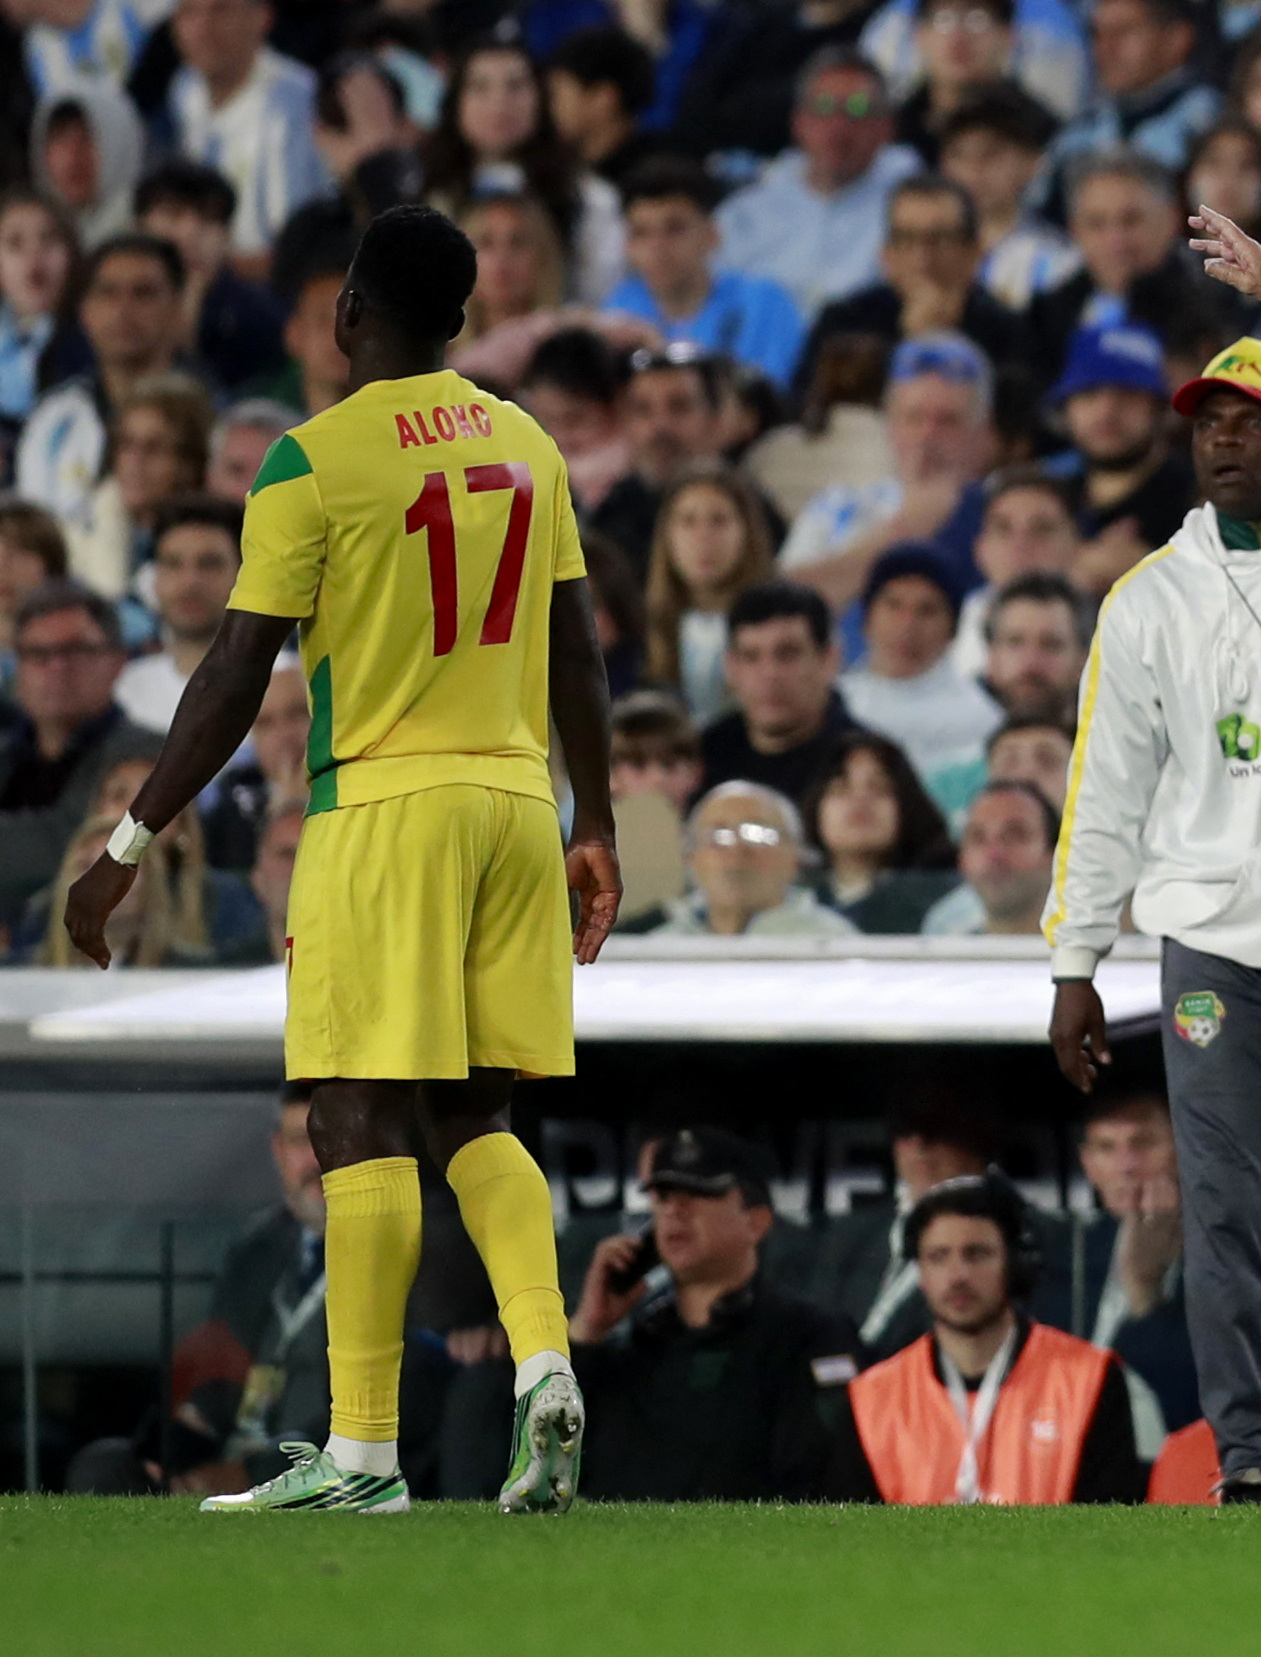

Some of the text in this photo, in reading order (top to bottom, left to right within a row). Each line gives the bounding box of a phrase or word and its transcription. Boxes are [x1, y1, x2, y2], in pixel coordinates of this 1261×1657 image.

[394, 402, 492, 449] ALOKO
[405, 461, 533, 657] 17
[1229, 764, 1249, 778] Un
